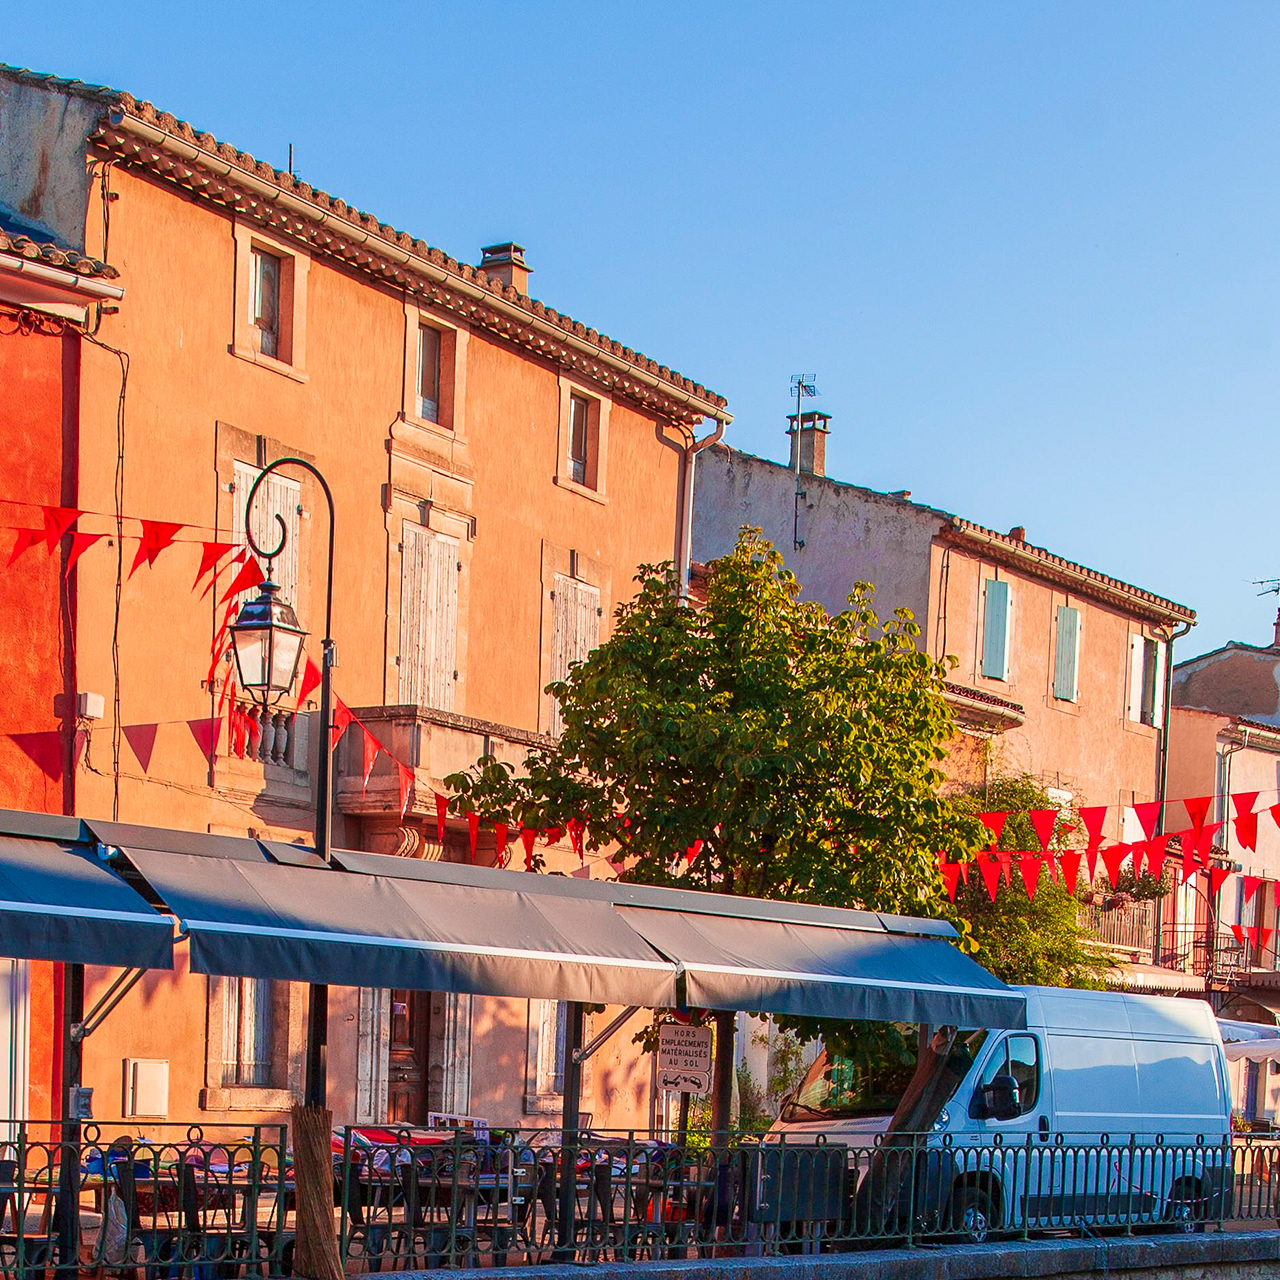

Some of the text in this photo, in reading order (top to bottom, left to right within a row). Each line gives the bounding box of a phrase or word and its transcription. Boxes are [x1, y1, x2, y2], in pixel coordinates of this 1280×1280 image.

[674, 1029, 697, 1038] HORS
[661, 1038, 709, 1049] EMPLACEMENTS
[660, 1047, 708, 1058] MATÉRIALISÉS
[668, 1058, 700, 1068] AU SOL
